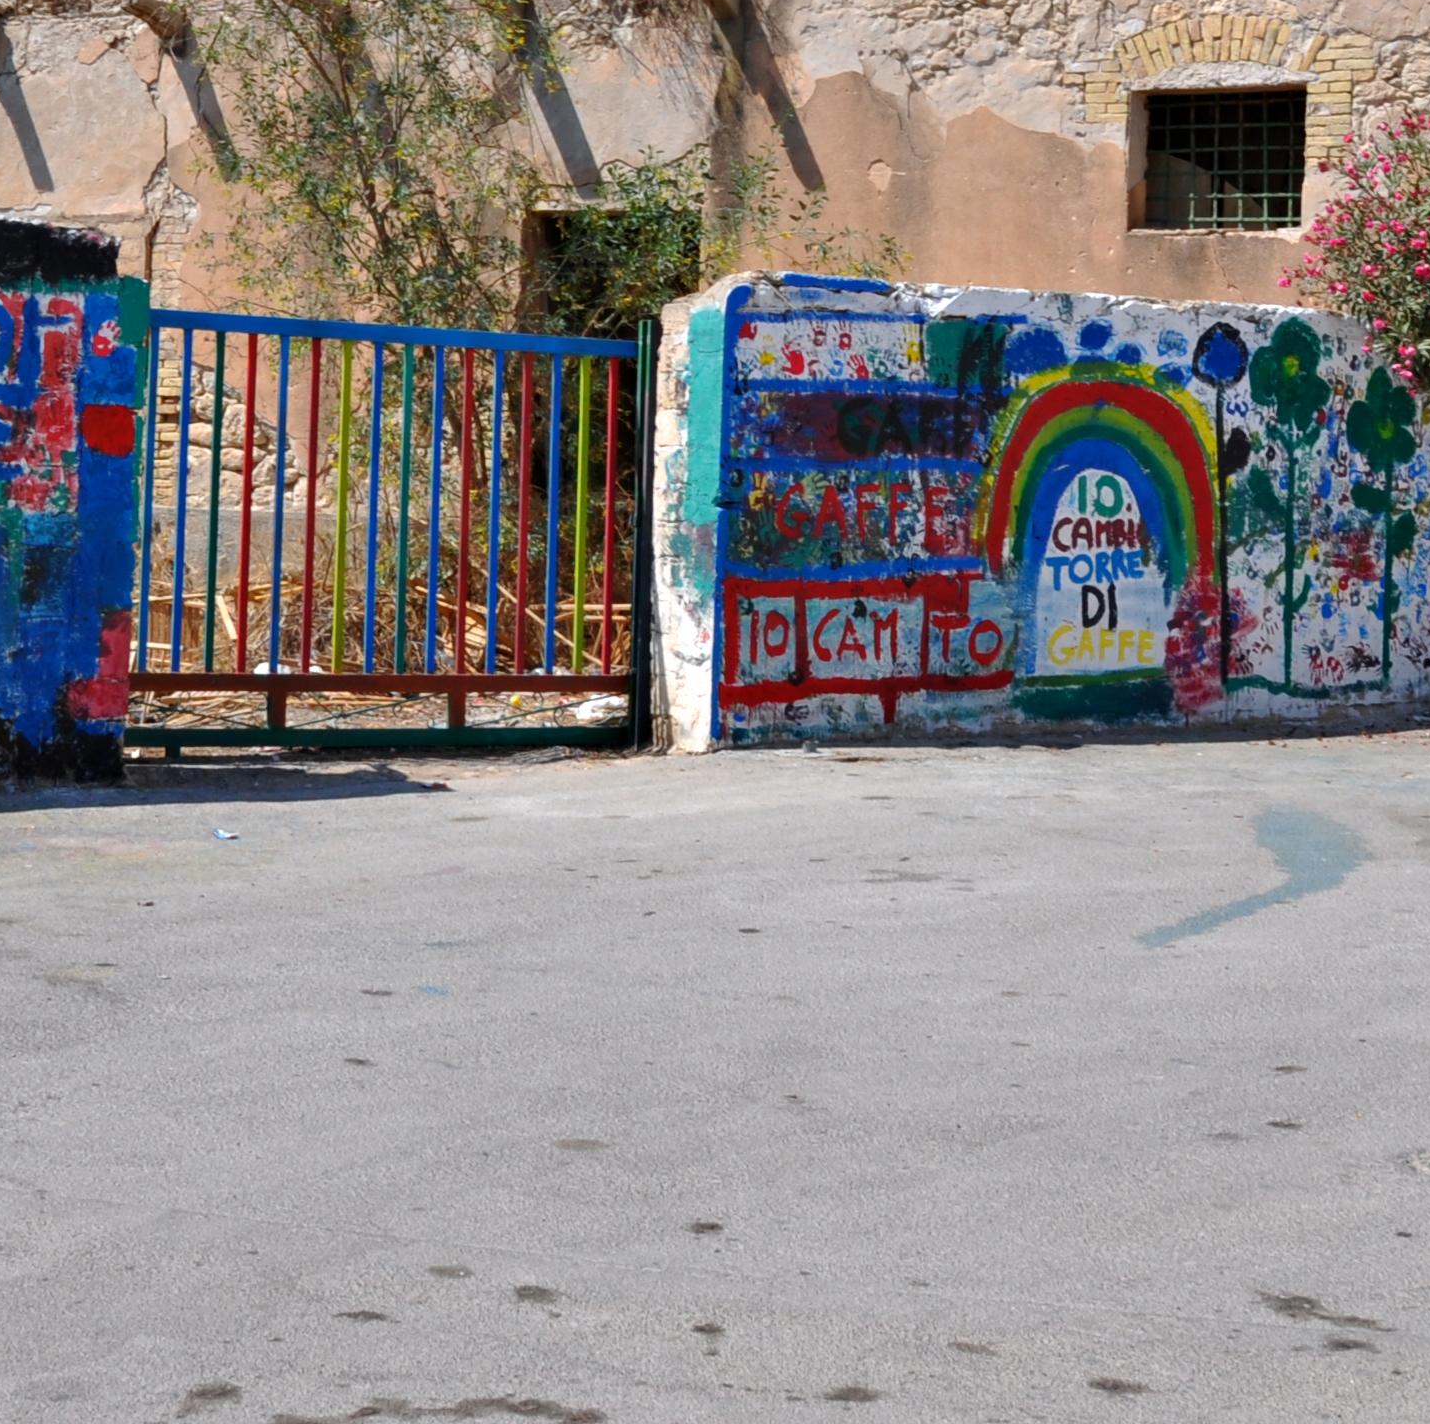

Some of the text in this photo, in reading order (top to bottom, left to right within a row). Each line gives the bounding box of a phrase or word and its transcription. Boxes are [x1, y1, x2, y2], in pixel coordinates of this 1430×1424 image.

[776, 483, 949, 552] GAFFE
[1045, 548, 1145, 591] TORRE
[1081, 582, 1118, 631] DI
[1047, 623, 1155, 667] GAFFE
